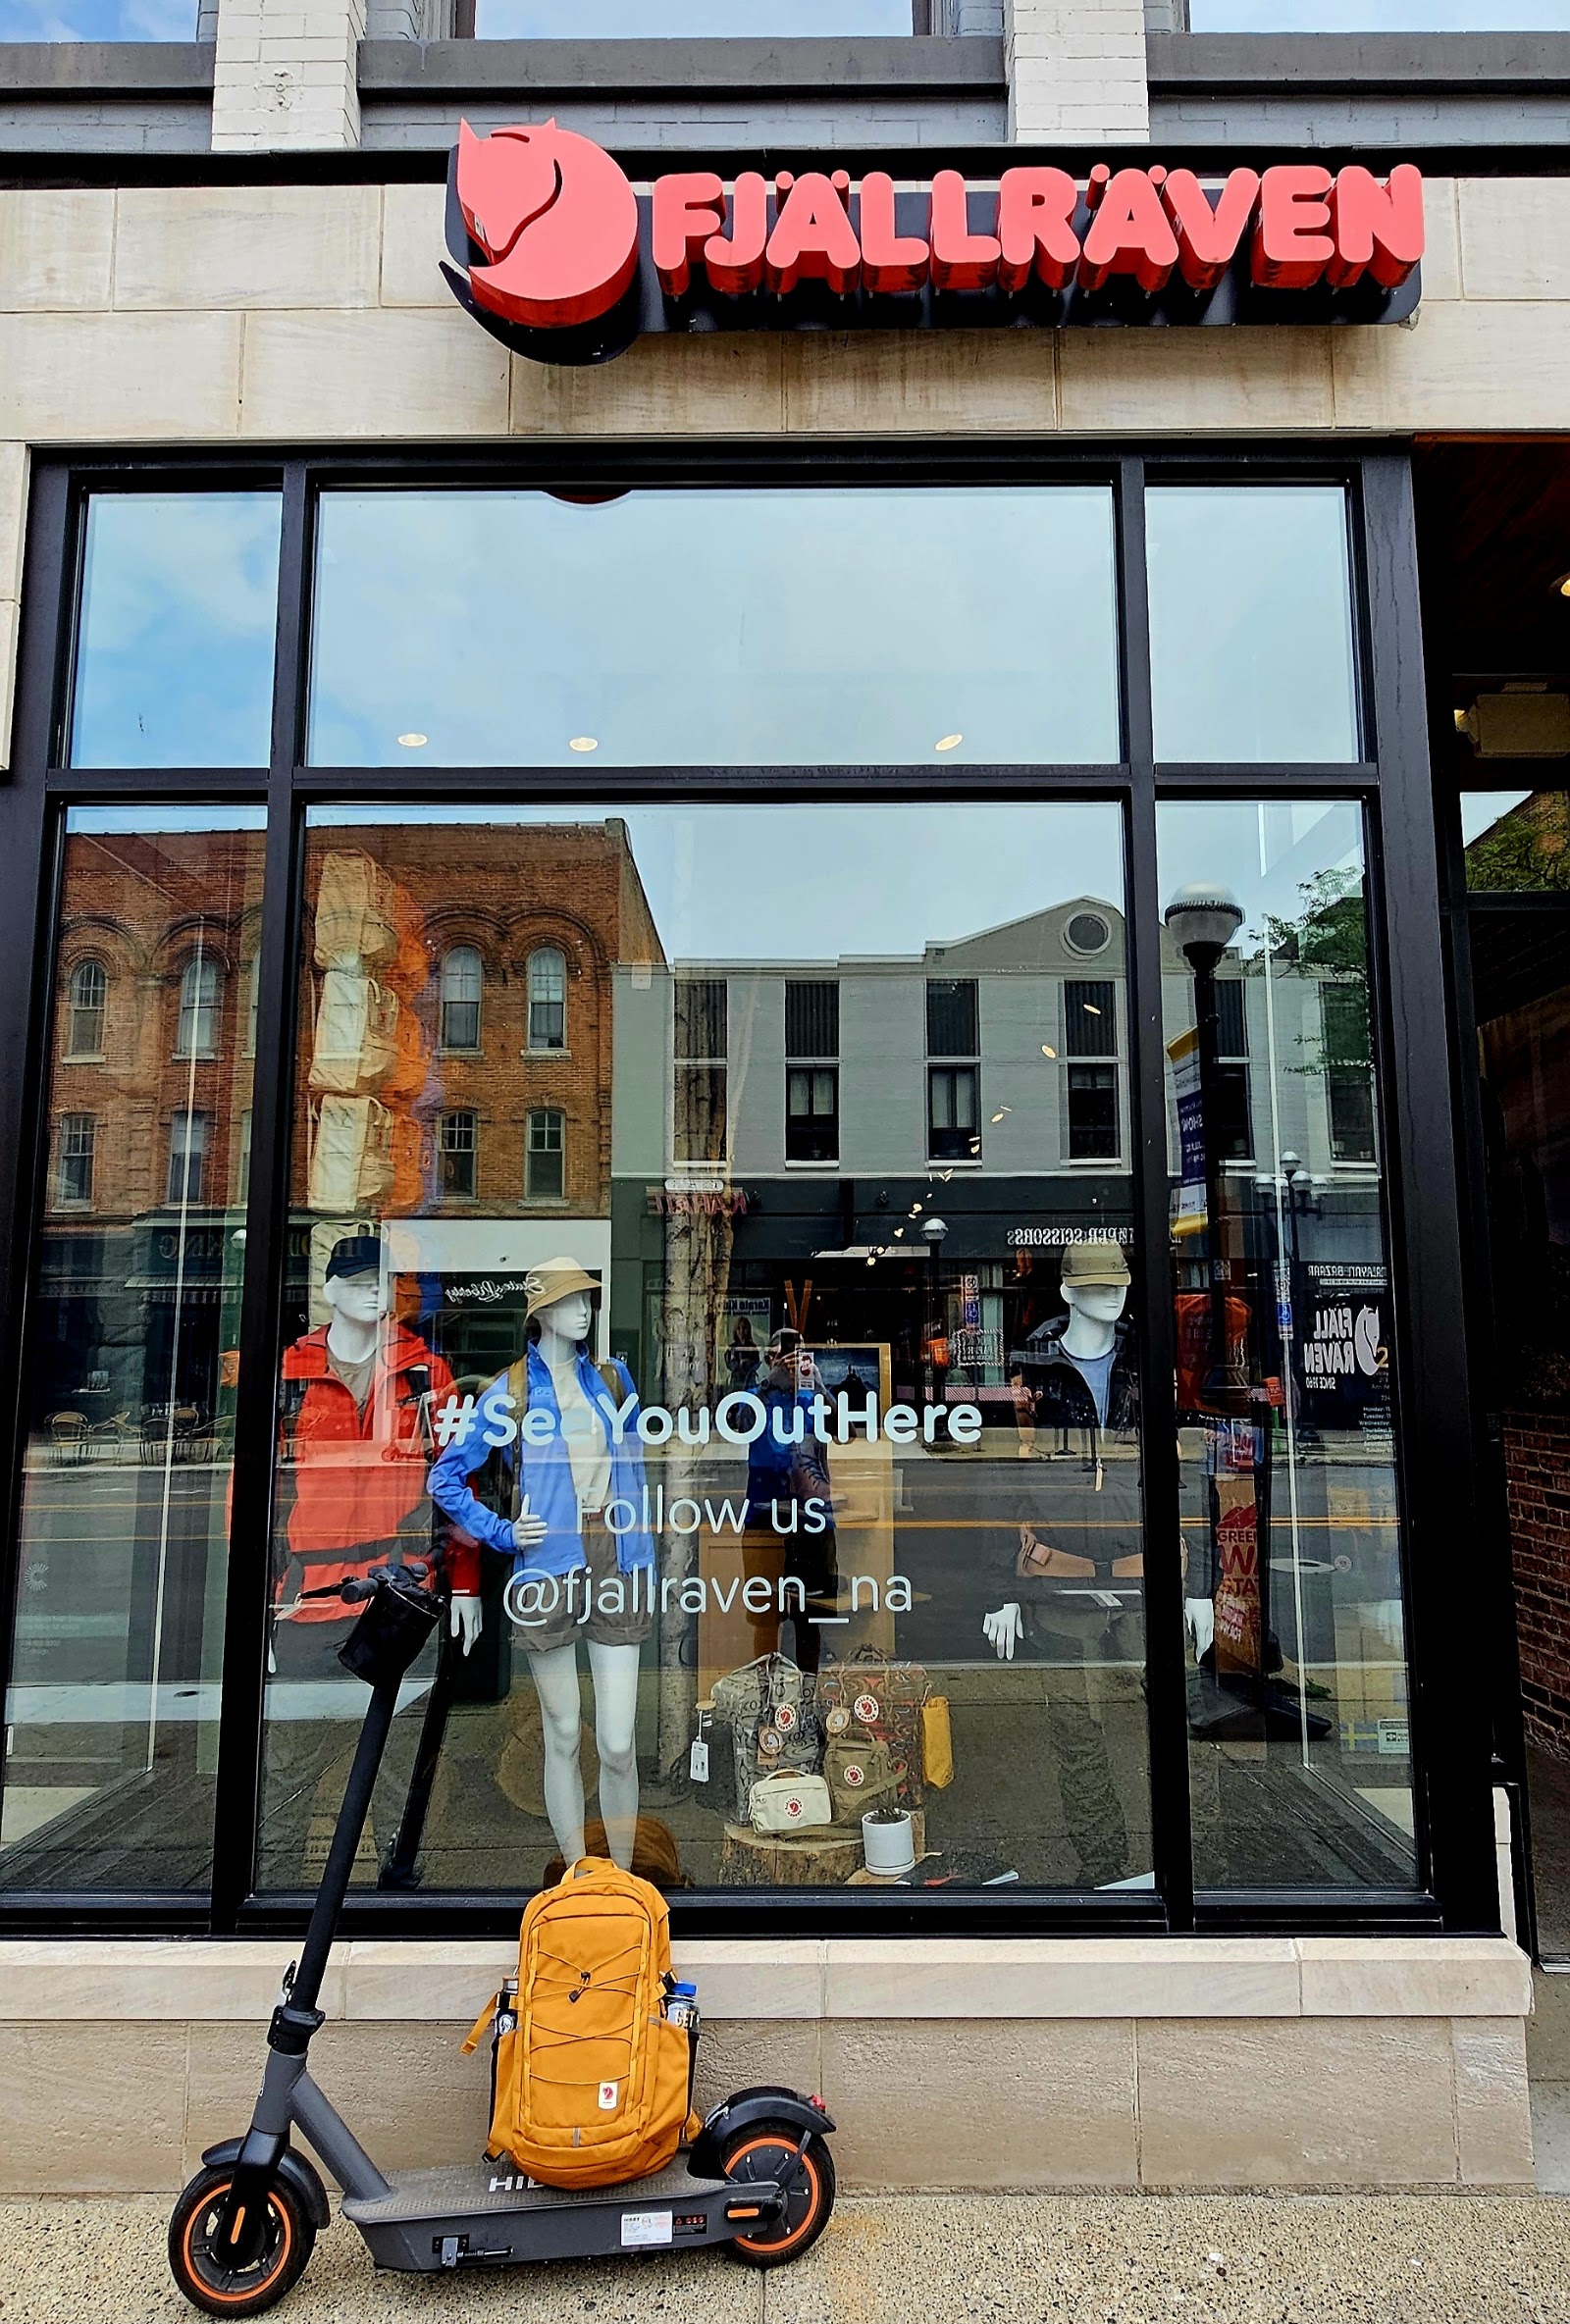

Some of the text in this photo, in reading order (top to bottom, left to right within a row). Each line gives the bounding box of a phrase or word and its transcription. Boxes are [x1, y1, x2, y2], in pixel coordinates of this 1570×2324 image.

[651, 163, 1425, 286] FJÄLLRÄVEN
[576, 1484, 827, 1534] Follow us
[1217, 1529, 1257, 1544] GREE
[1218, 1545, 1258, 1575] W
[501, 1564, 914, 1627] @fjallraven_na
